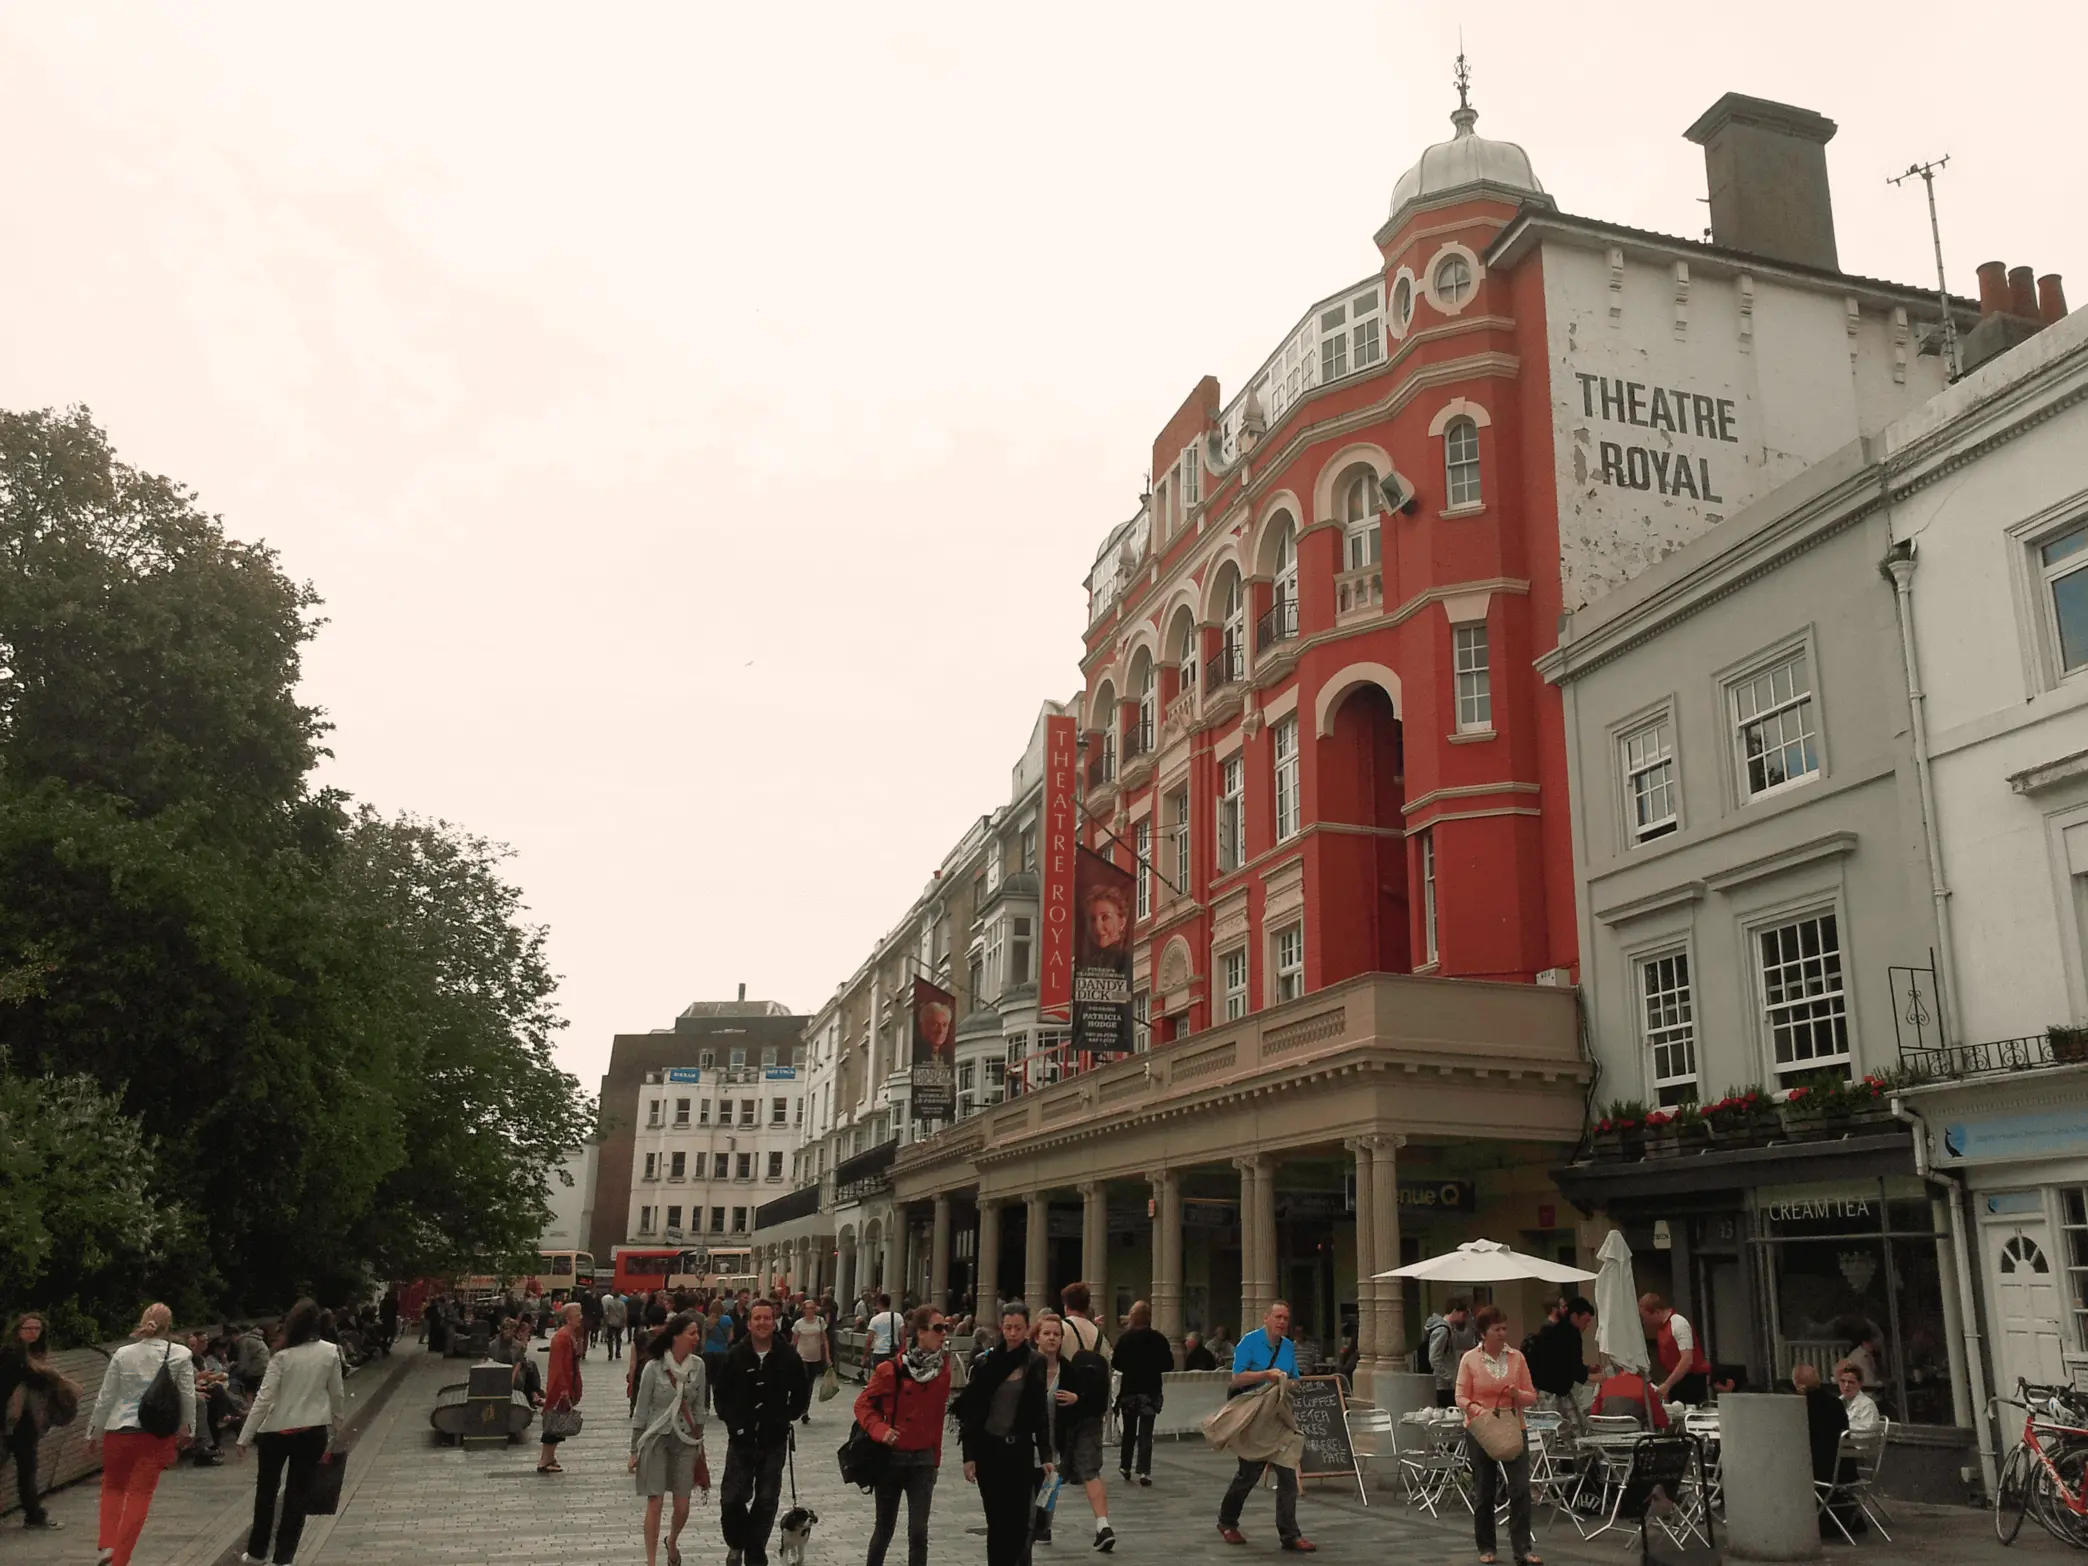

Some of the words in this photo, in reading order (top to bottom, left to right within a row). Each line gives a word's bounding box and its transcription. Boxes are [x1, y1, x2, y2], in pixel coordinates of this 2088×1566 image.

[1575, 372, 1738, 442] THEATRE
[1600, 441, 1722, 503] ROYAL
[1053, 730, 1068, 873] THEATRE
[1049, 884, 1066, 989] ROYAL
[1077, 979, 1125, 991] DANDY
[1077, 990, 1110, 1001] DICK
[1082, 1012, 1122, 1021] PATRICIA
[1440, 1184, 1461, 1206] Q
[1768, 1199, 1829, 1221] CREAM
[1835, 1196, 1870, 1218] TEA
[1303, 1394, 1337, 1408] COFFEE
[1307, 1409, 1330, 1424] TEA
